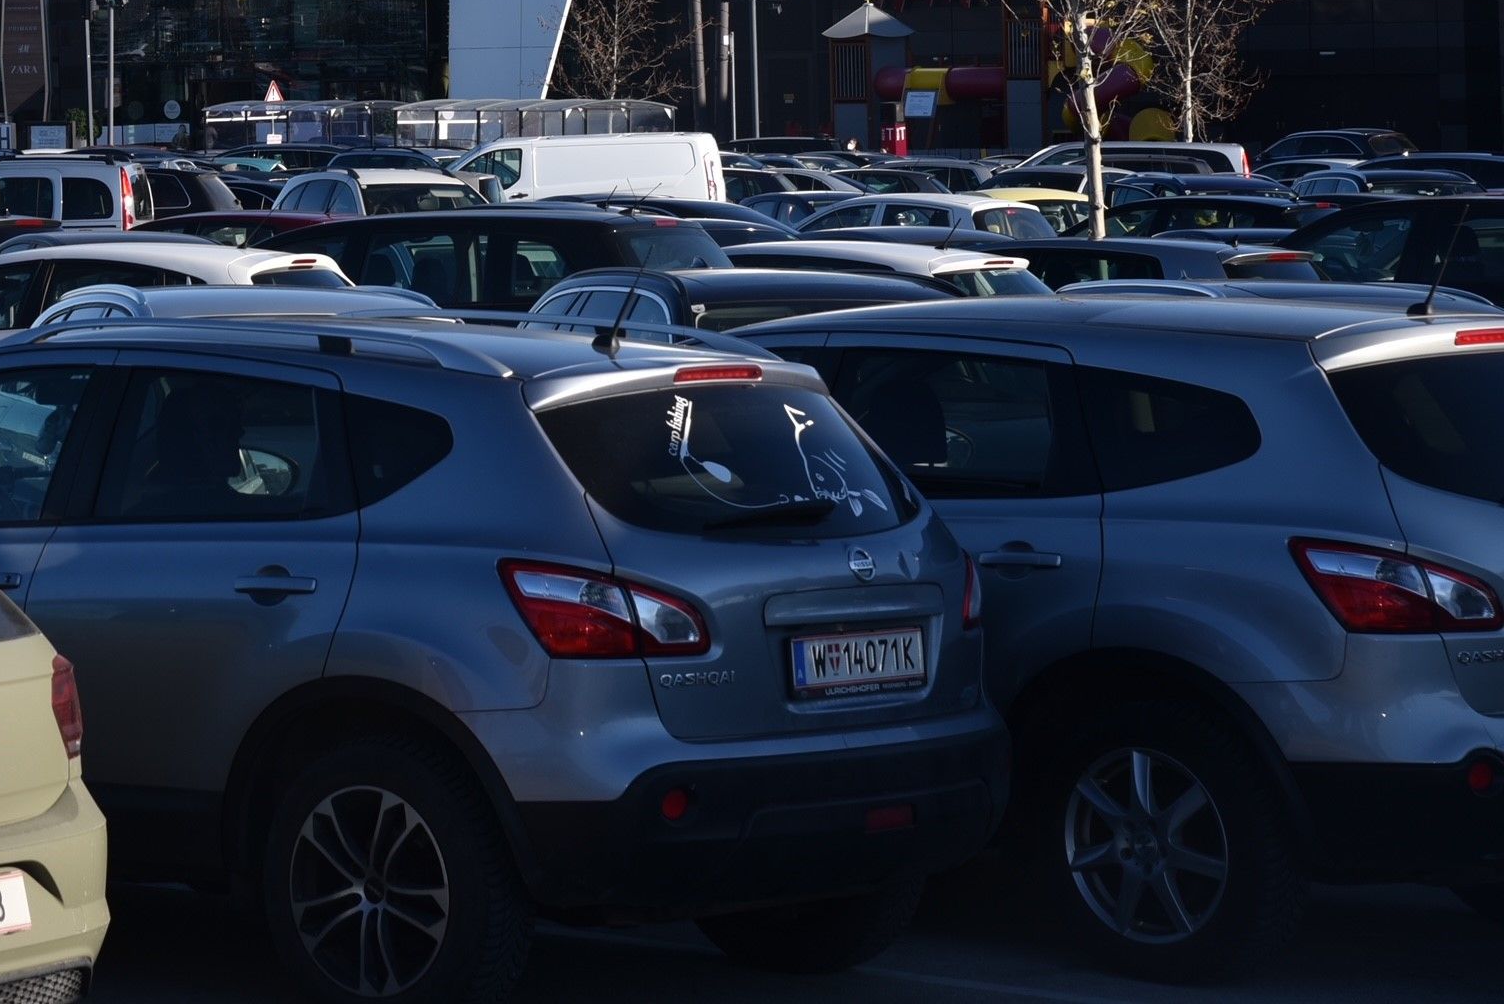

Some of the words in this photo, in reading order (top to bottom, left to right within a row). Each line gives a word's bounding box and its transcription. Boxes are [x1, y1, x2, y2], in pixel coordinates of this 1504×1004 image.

[9, 65, 37, 75] ZARA
[665, 394, 689, 433] fishing
[668, 429, 683, 457] carp
[810, 644, 827, 678] W
[842, 637, 915, 675] 14071K
[659, 670, 736, 687] QASHQAI
